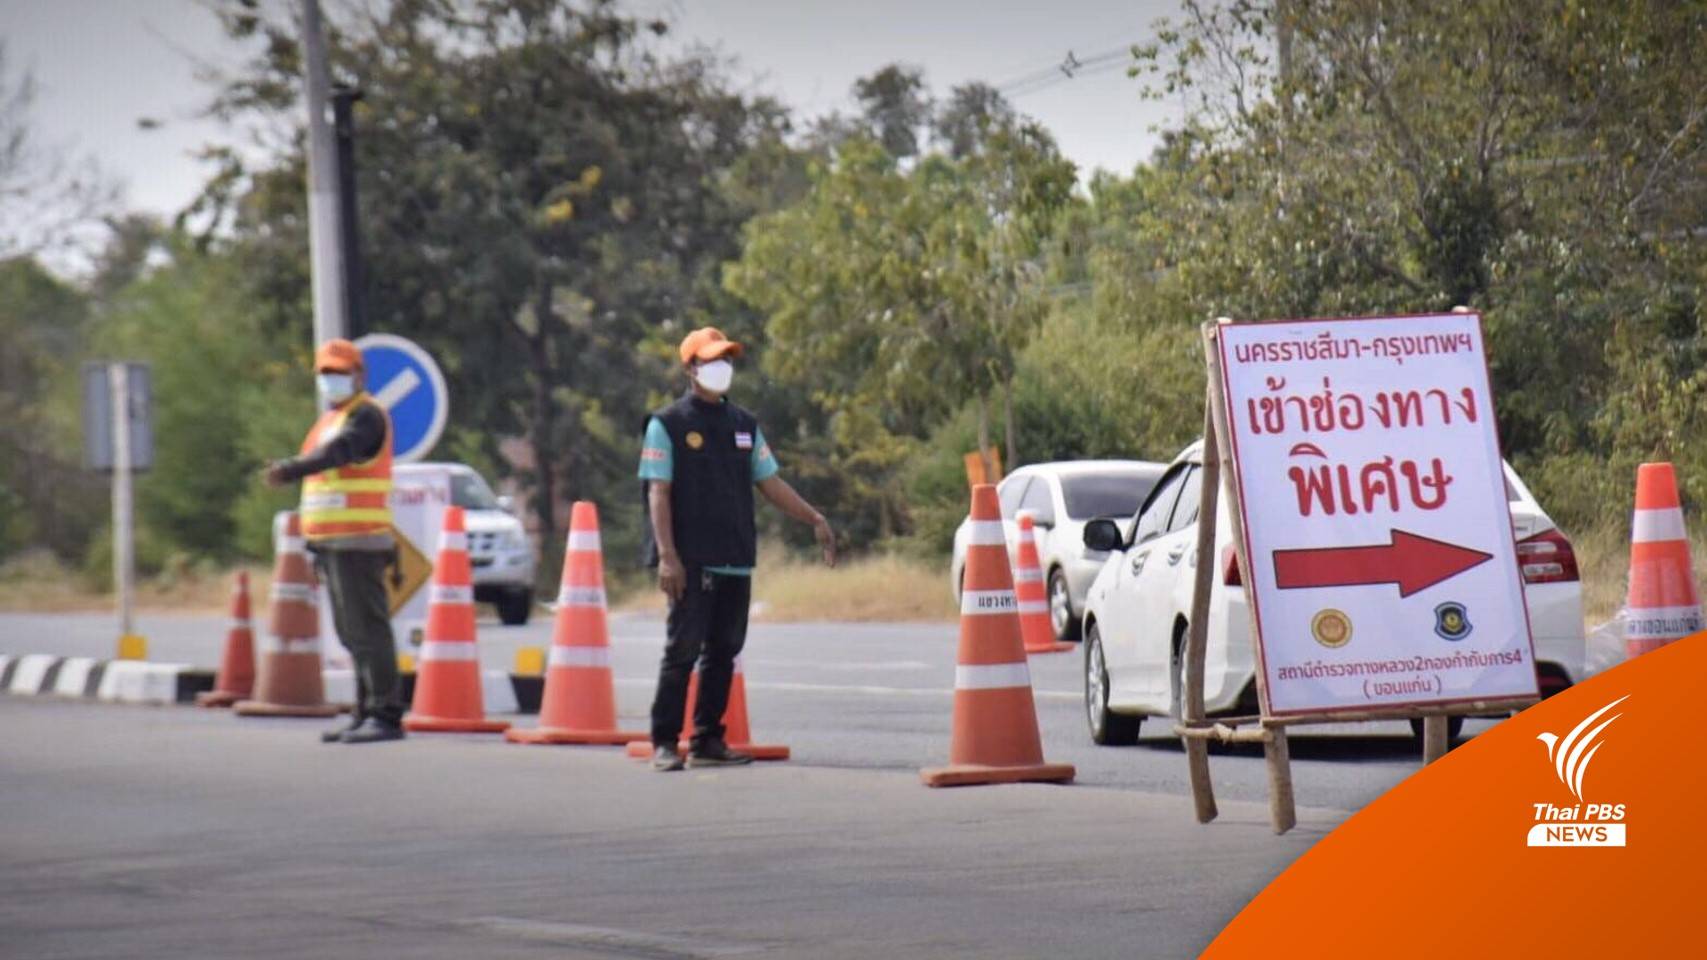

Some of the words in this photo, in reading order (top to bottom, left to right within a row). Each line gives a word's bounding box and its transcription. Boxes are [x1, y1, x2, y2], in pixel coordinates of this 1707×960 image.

[1235, 331, 1473, 365] นครราชสีมา-กรุงเทพฯ
[1248, 376, 1477, 434] เข้าช่องทาง
[1288, 443, 1453, 516] พิเศษ
